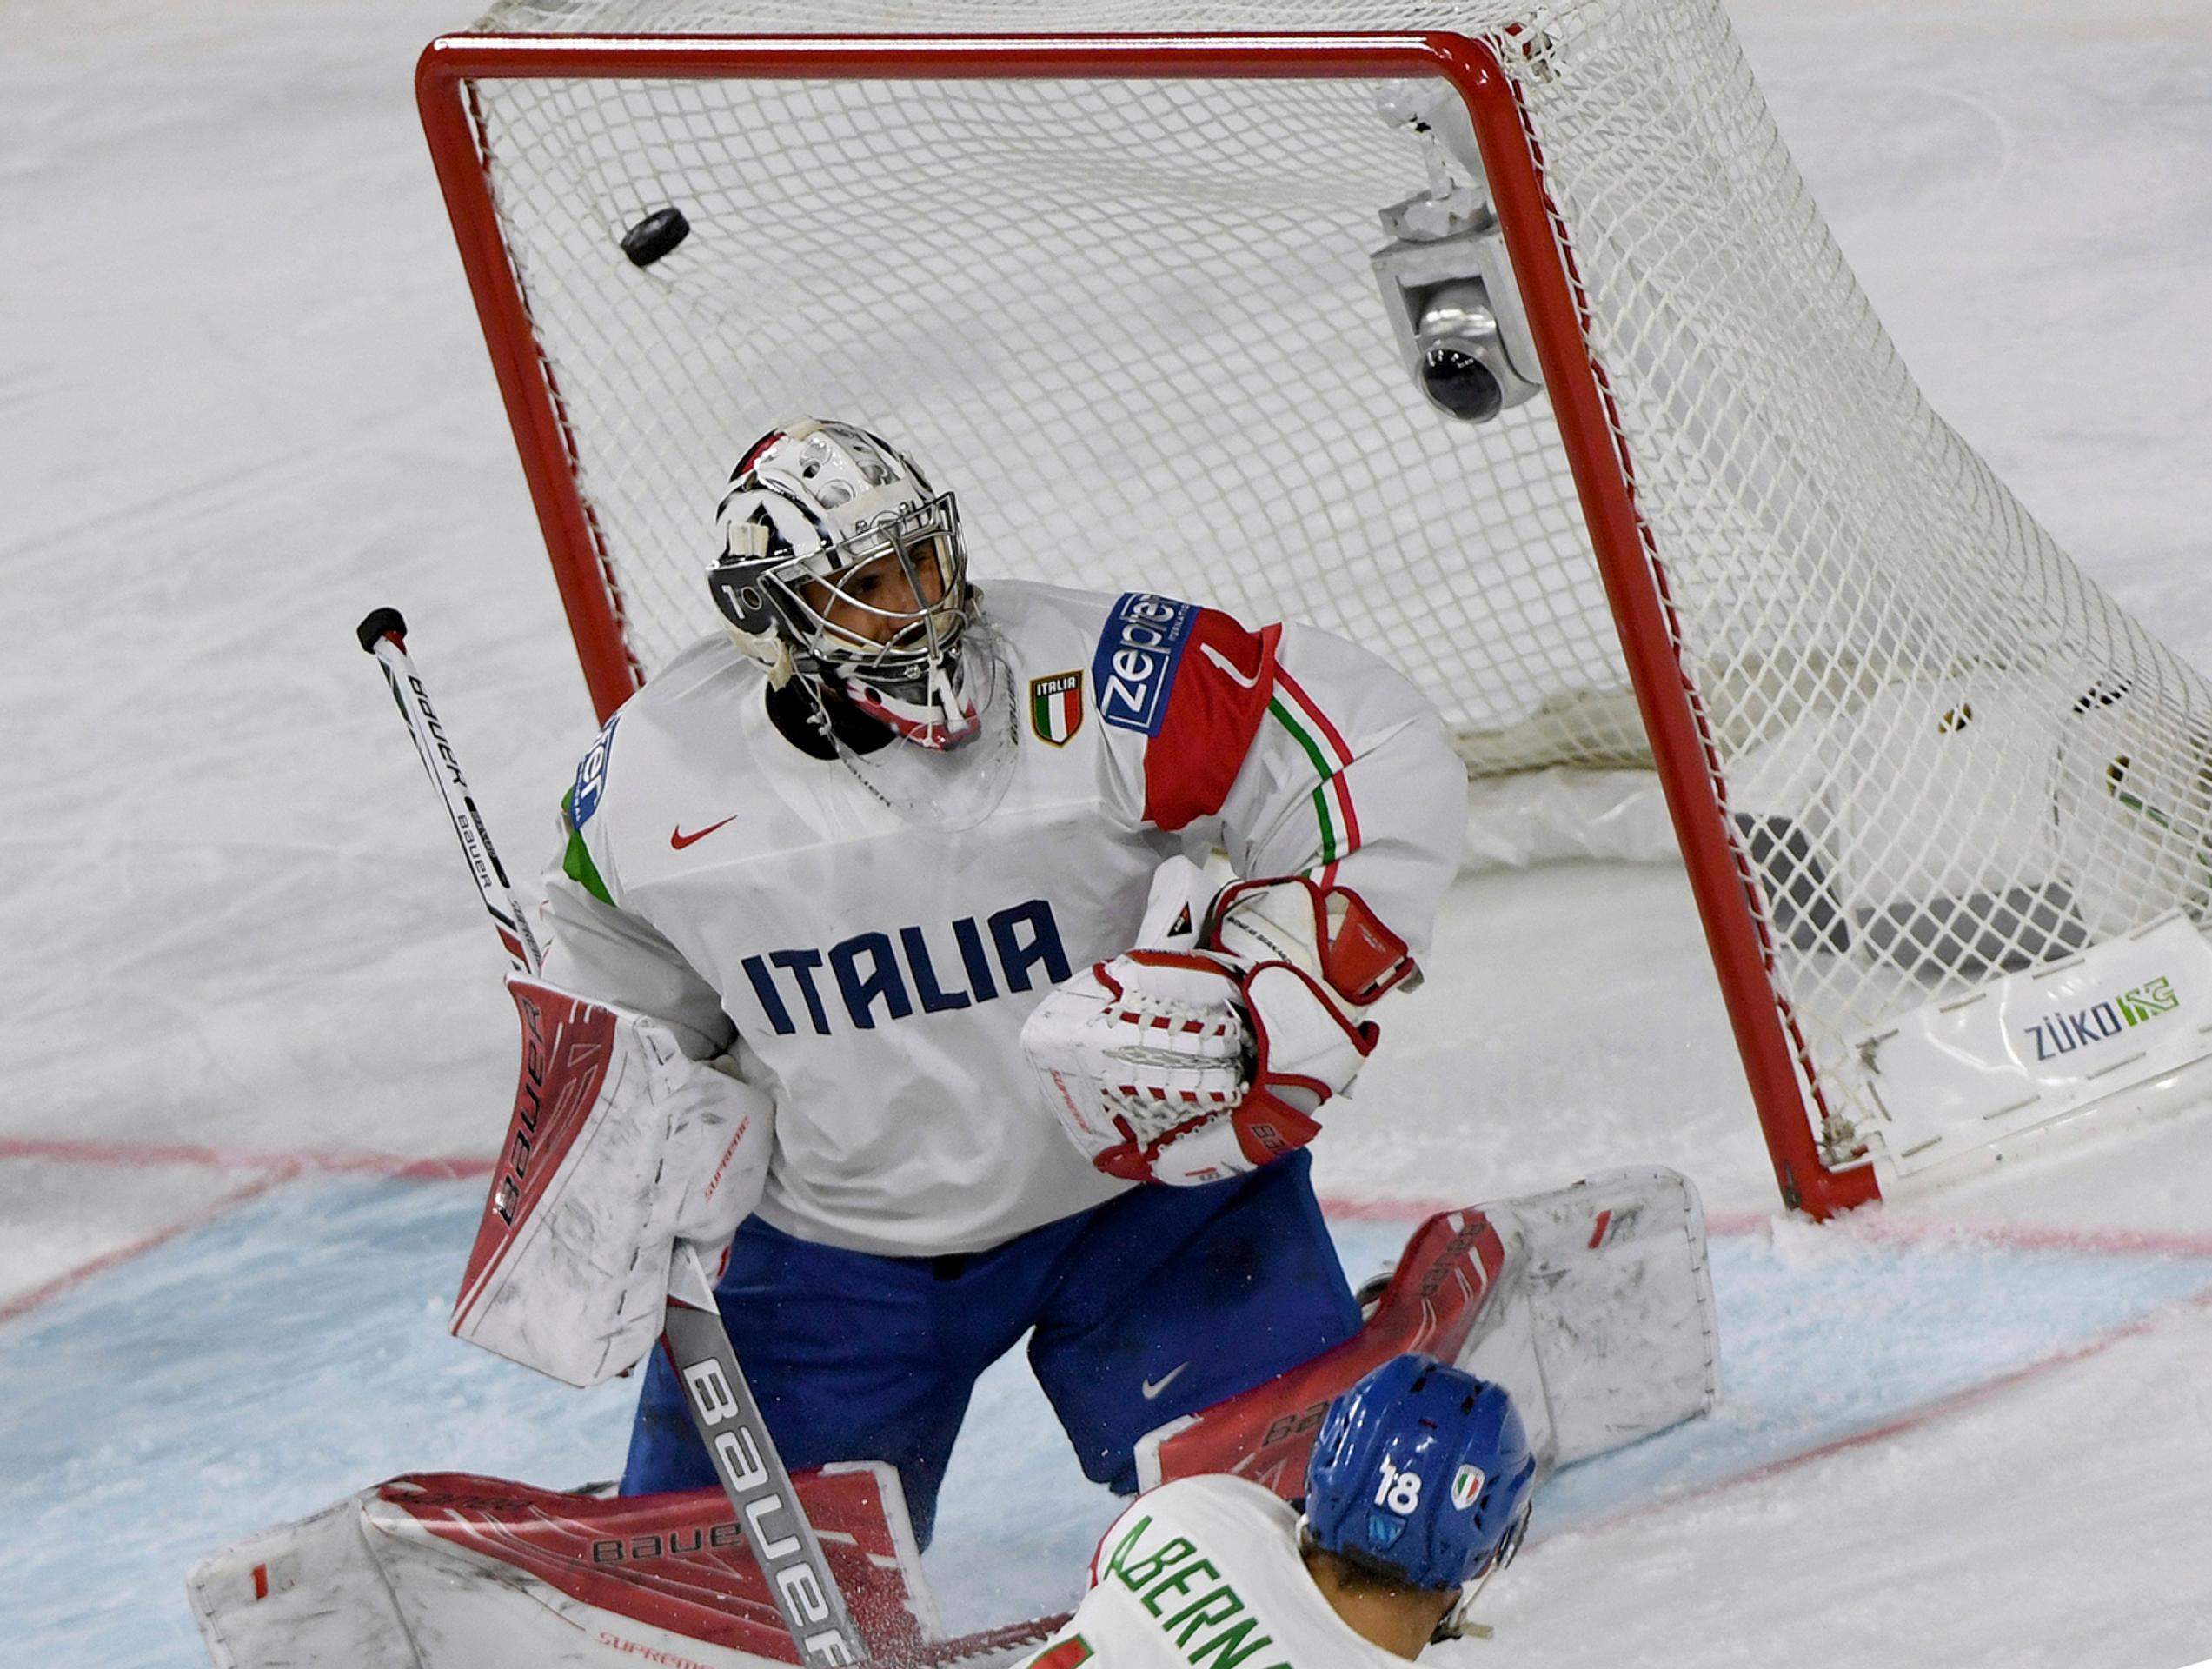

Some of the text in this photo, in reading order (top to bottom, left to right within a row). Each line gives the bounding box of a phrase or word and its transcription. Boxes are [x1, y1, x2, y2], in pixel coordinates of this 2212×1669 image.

[1036, 676, 1076, 696] ITALIA
[457, 815, 492, 888] BAUER
[740, 898, 1073, 1035] ITALIA
[496, 997, 543, 1228] BAUER
[1373, 1452, 1423, 1515] 18
[592, 1522, 743, 1564] BAUE
